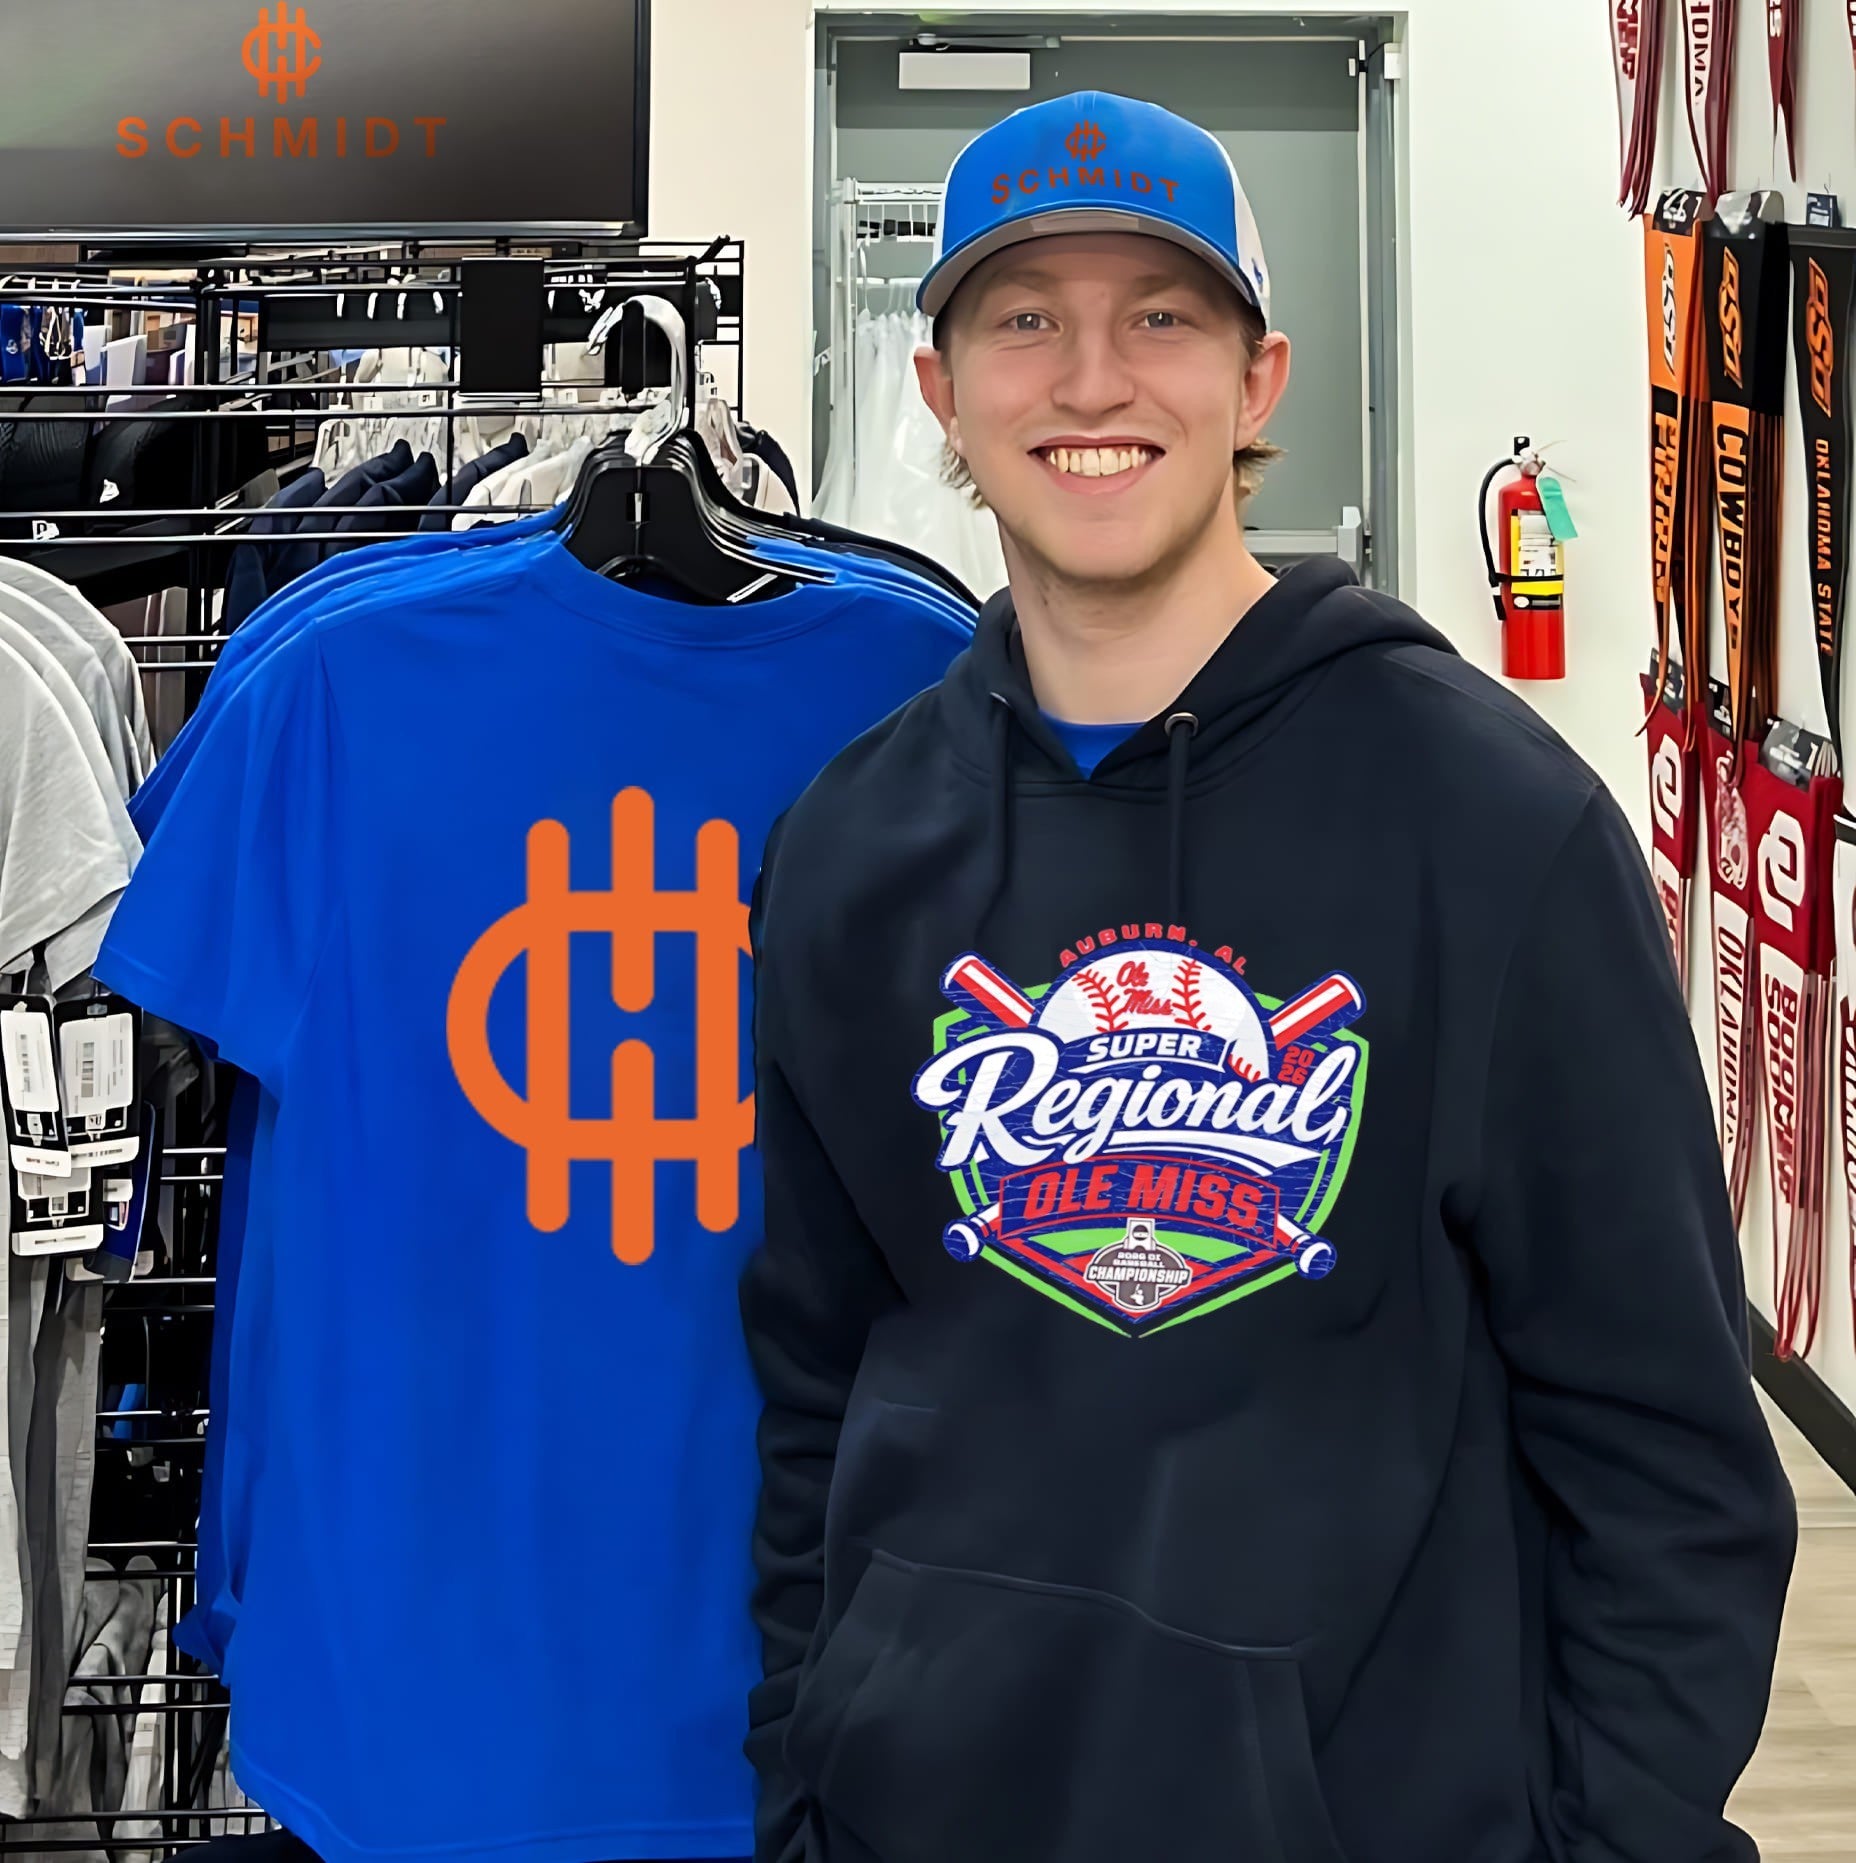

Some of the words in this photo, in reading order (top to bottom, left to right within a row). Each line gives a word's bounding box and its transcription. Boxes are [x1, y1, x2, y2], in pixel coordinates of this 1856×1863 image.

[116, 116, 447, 158] SCHMIDT
[992, 167, 1179, 204] SCHMIDT
[1816, 438, 1832, 570] OKLAHOMA
[1214, 945, 1247, 975] AL
[1086, 1033, 1203, 1062] SUPER
[915, 1032, 1357, 1168] Regional
[1023, 1165, 1119, 1220] OLE
[1126, 1165, 1263, 1230] MISS
[1088, 1265, 1190, 1284] CHAMPIONSHIP
